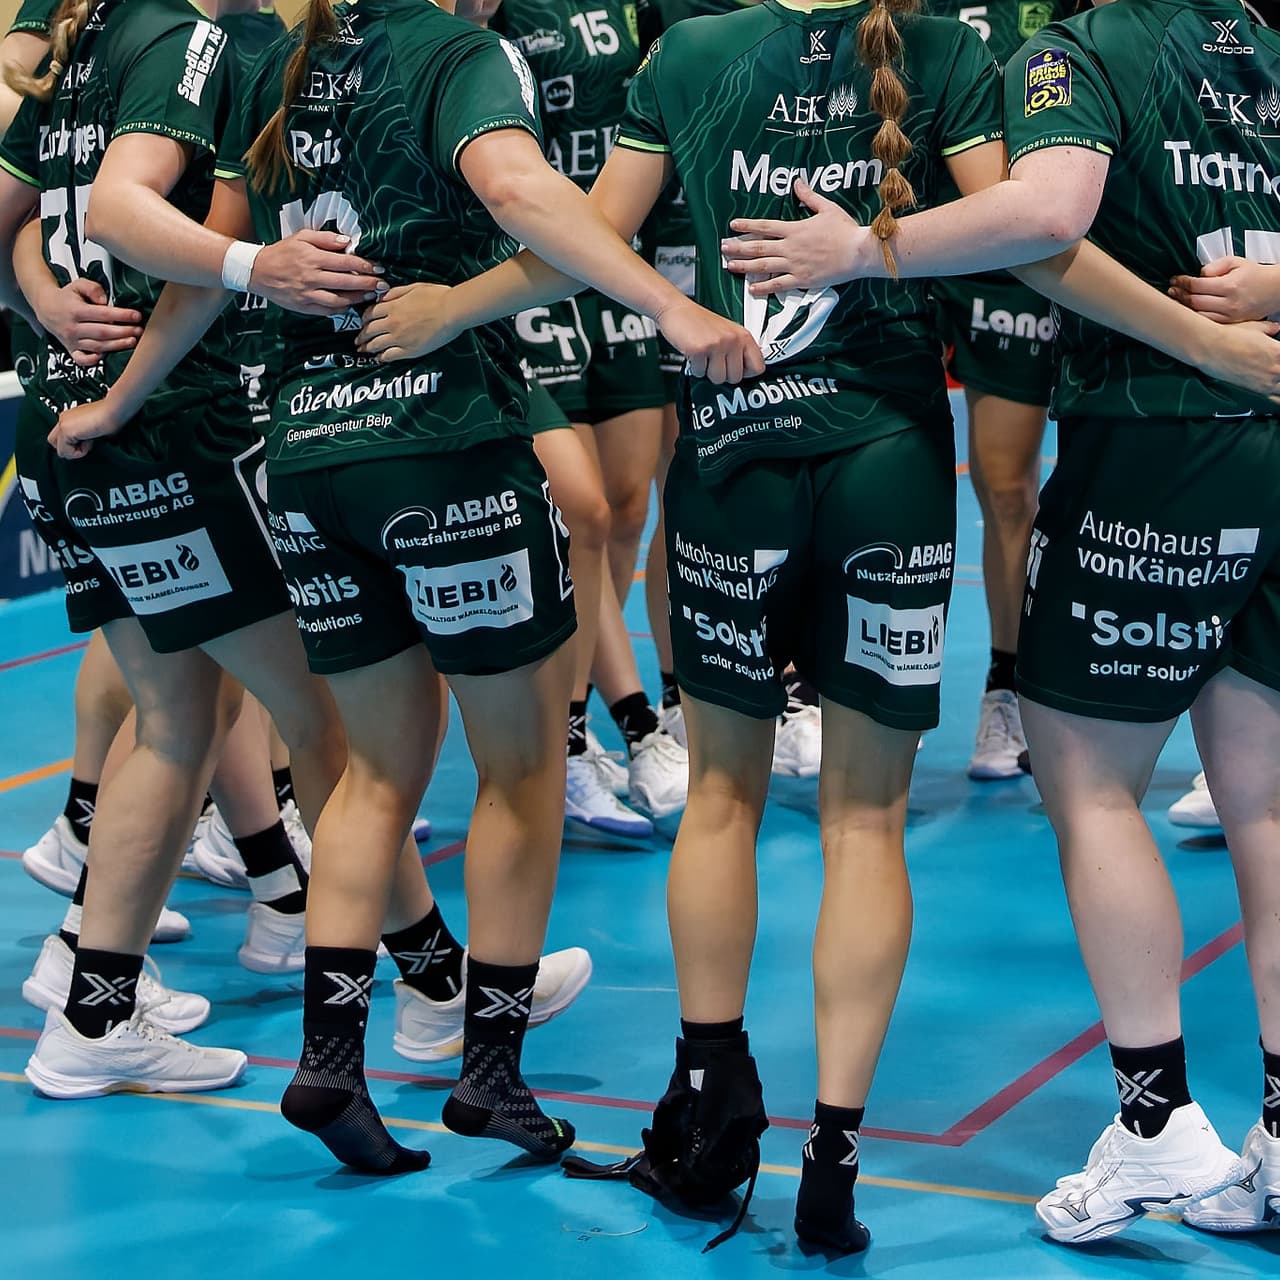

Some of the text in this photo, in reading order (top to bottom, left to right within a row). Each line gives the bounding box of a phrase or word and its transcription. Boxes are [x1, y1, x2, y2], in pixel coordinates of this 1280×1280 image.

[570, 10, 619, 56] 15
[300, 71, 345, 101] EK
[692, 373, 841, 431] ie Mobiliar
[366, 412, 392, 430] Belp
[697, 414, 802, 458] eneralagentur Belp
[109, 472, 189, 509] ABAG
[445, 489, 518, 527] ABAG
[72, 494, 194, 528] Nutzfahrzeuge AG
[394, 513, 522, 550] Nutzfahrzeuge AG
[1079, 510, 1212, 557] Autohaus
[675, 531, 749, 574] Autohaus
[908, 542, 953, 568] ABAG
[108, 558, 180, 590] IEBI
[856, 567, 951, 585] Nutzfahrzeuge AG
[701, 652, 733, 671] solar
[1090, 660, 1142, 676] solar
